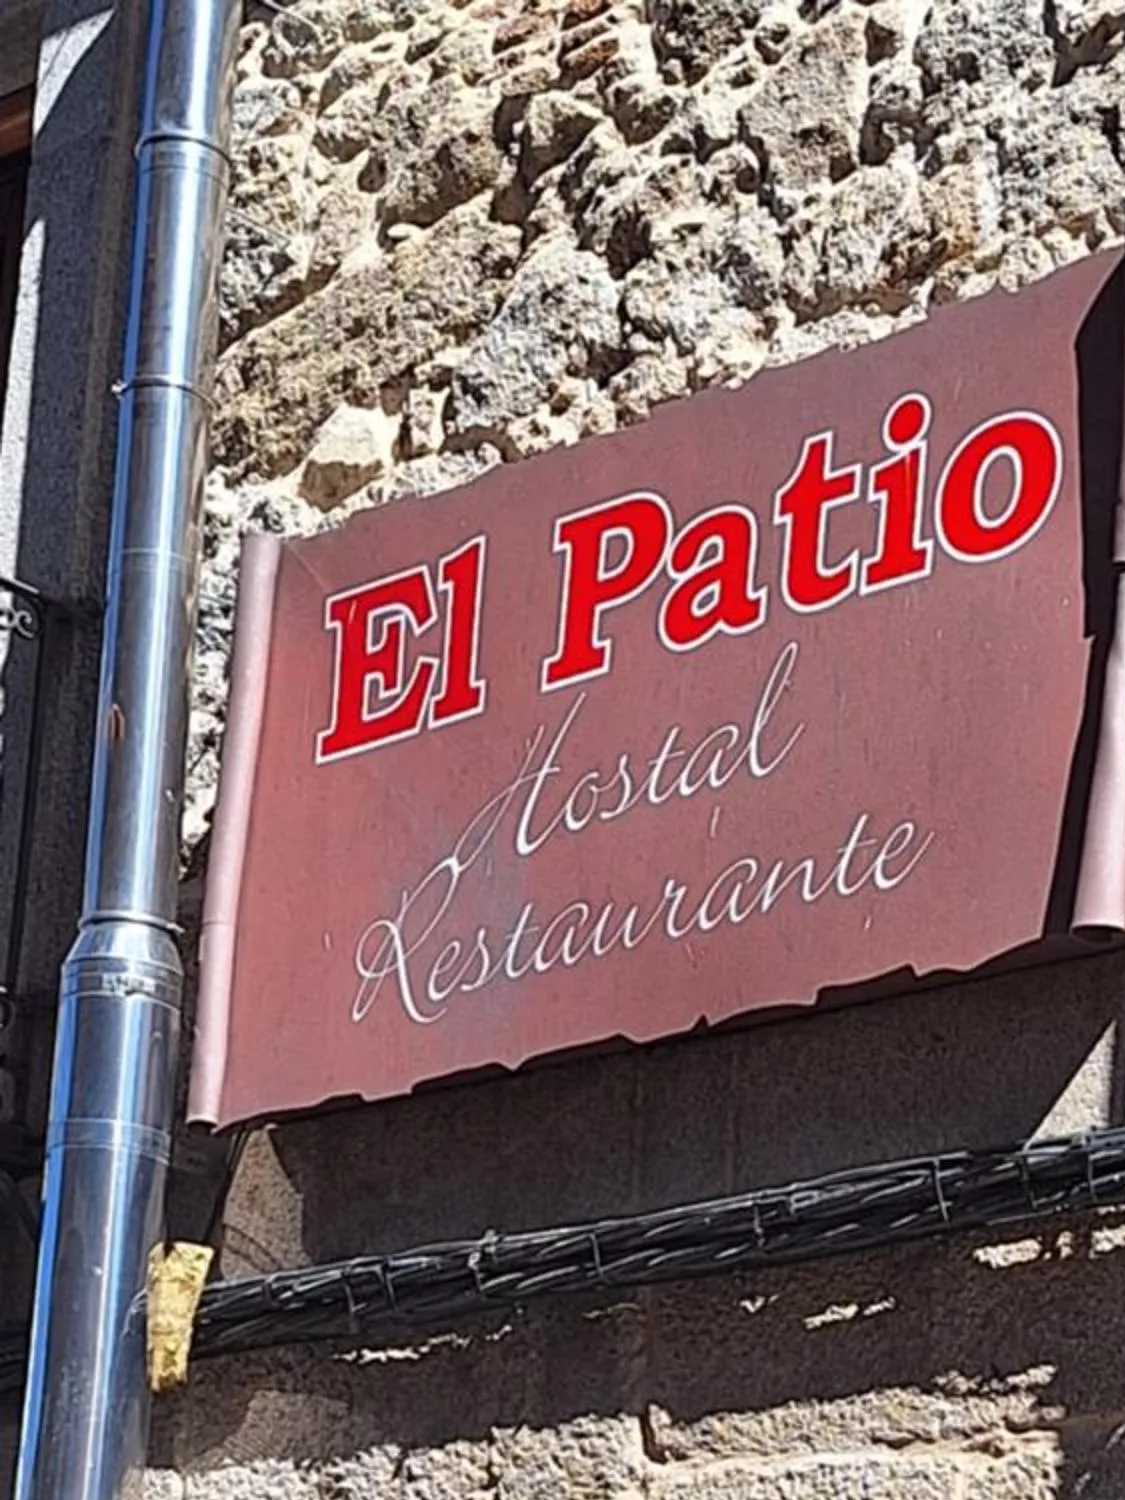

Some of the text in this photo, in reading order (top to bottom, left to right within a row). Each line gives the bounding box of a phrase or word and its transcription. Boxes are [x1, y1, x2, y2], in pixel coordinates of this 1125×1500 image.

[316, 391, 1063, 765] El Patio
[453, 641, 805, 876] Hostal
[352, 813, 935, 1022] Restaurante
